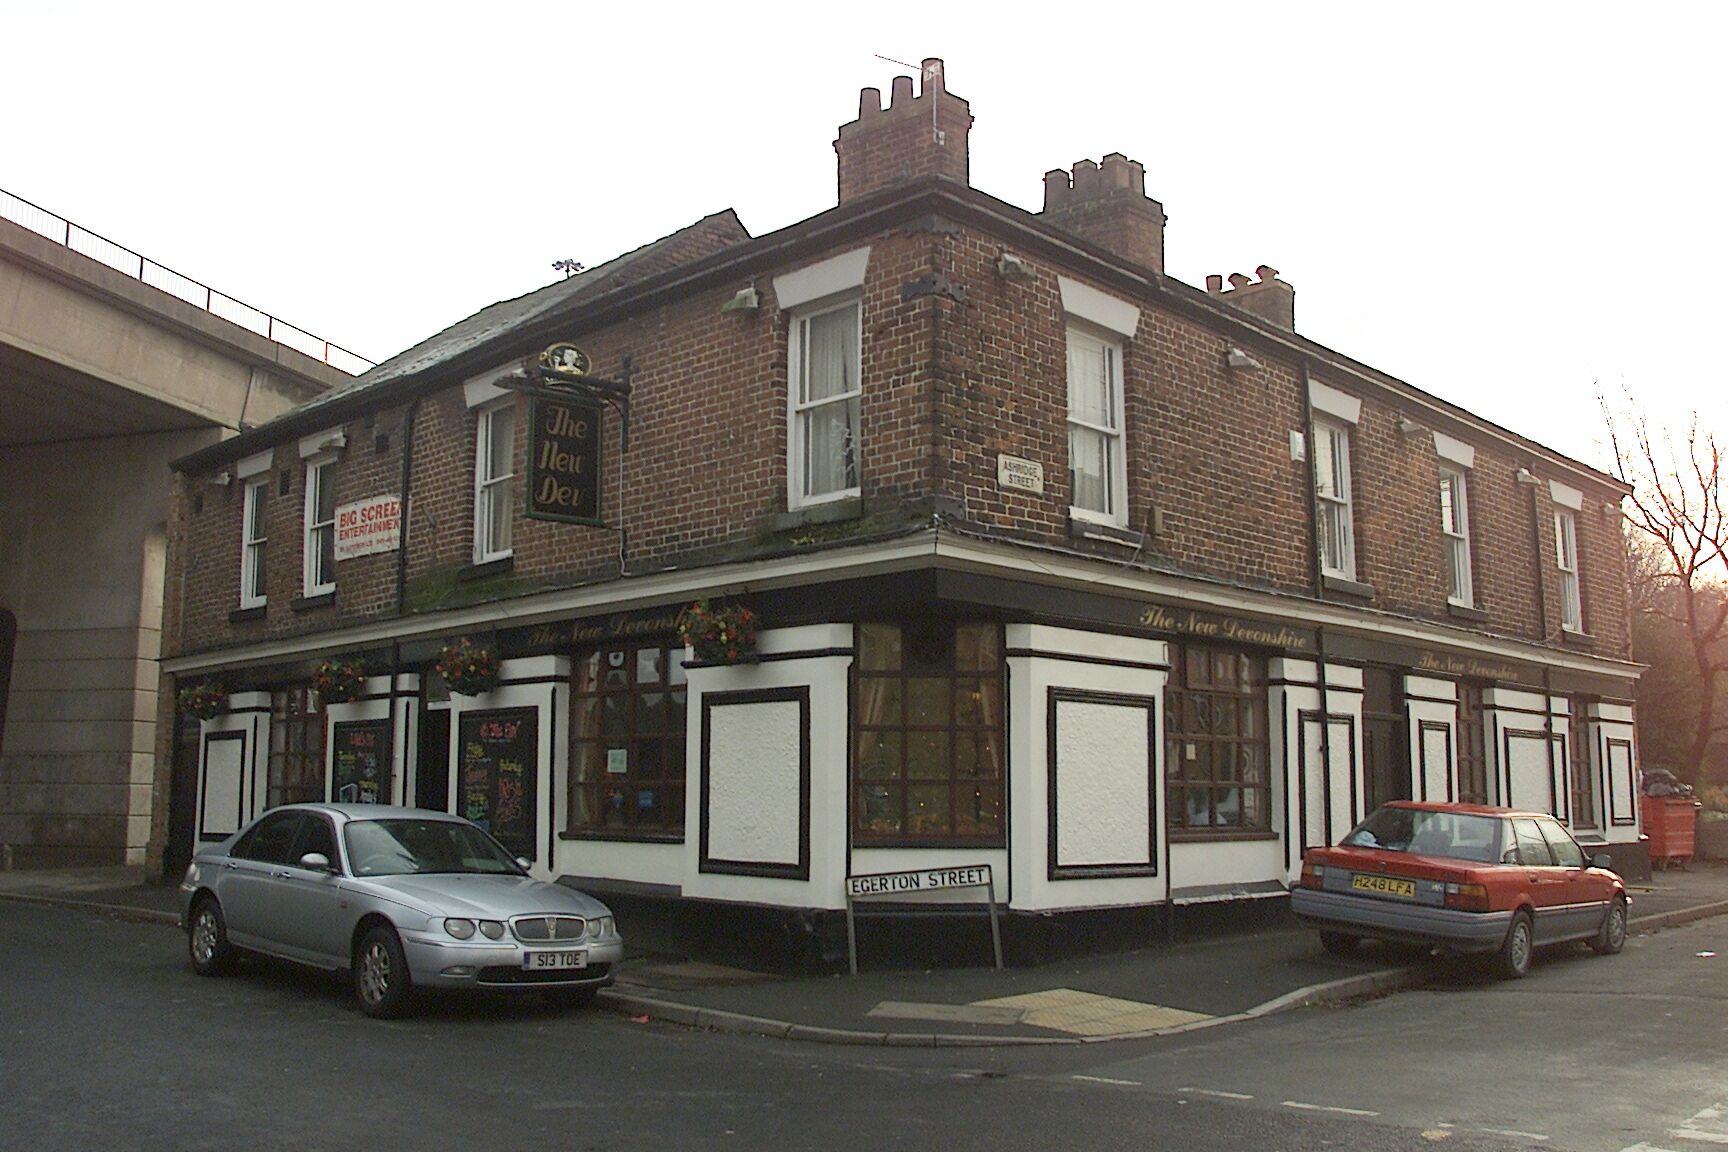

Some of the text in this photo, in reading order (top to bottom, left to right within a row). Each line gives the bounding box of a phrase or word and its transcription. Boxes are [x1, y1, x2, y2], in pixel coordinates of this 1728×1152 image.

[546, 406, 587, 438] The
[1009, 473, 1034, 488] STREET
[340, 510, 357, 528] BIG
[340, 519, 400, 540] ENTERTAINMEN
[1139, 605, 1307, 648] The New Devonshire
[852, 869, 985, 894] EGERTON STREET
[1354, 876, 1412, 895] H248 LFA
[538, 953, 581, 967] S13 TOE
